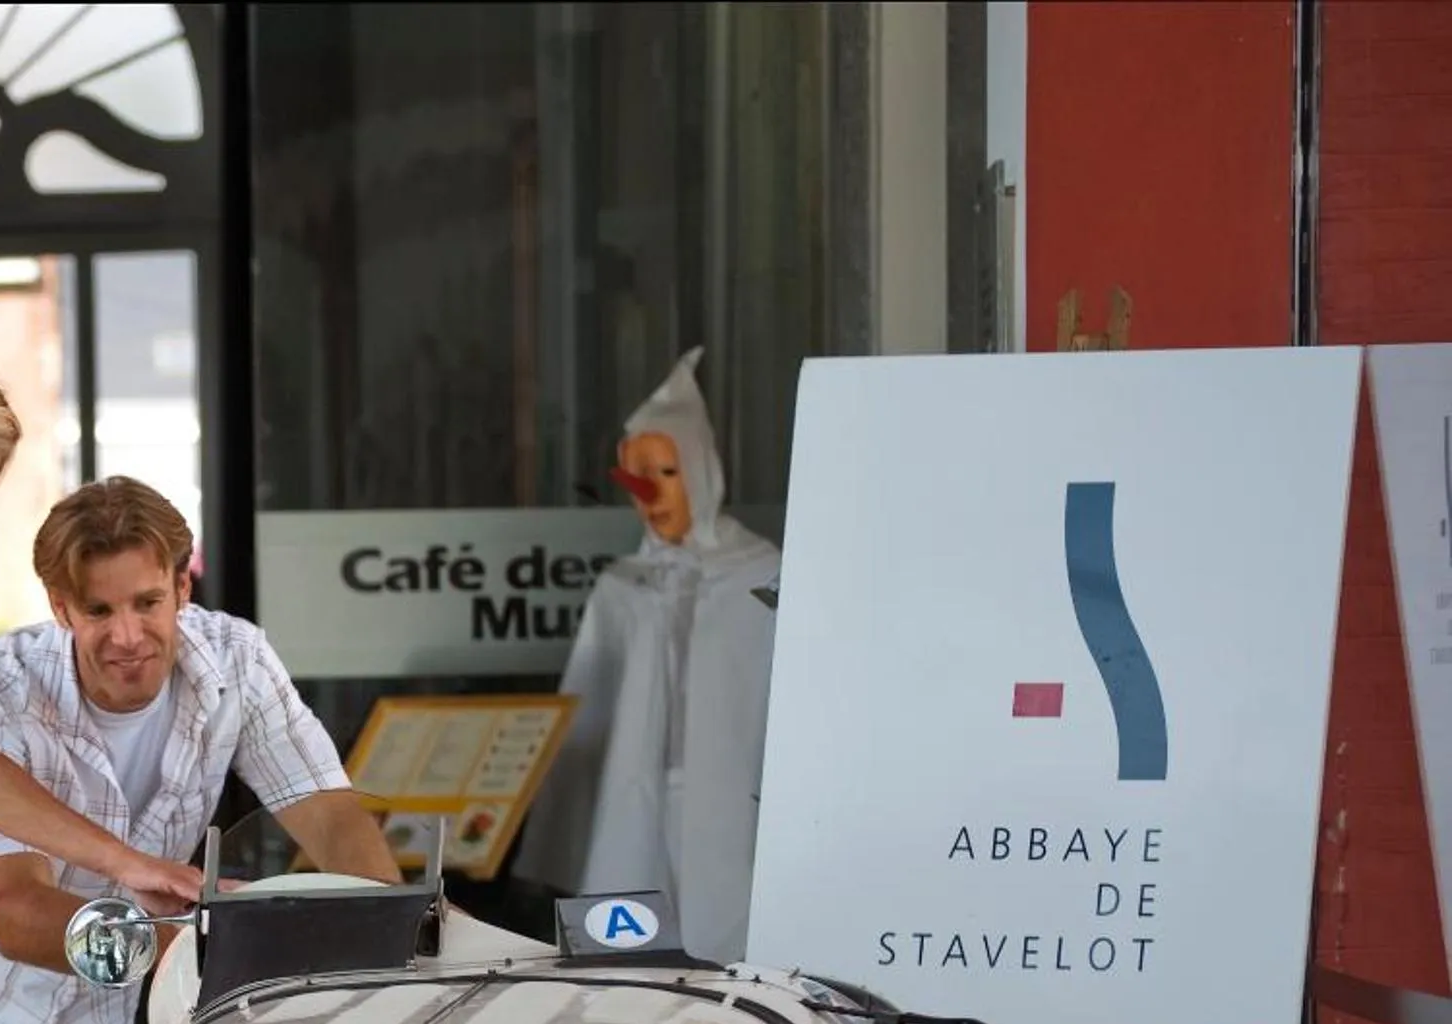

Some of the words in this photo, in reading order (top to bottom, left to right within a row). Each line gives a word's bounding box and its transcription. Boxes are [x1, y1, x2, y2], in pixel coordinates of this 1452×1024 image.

[341, 543, 485, 593] Café
[506, 545, 618, 592] des
[472, 595, 585, 641] Mu
[947, 826, 1164, 863] ABBAYE
[1095, 882, 1157, 918] DE
[605, 904, 647, 939] A
[878, 932, 1154, 972] STAVELOT
